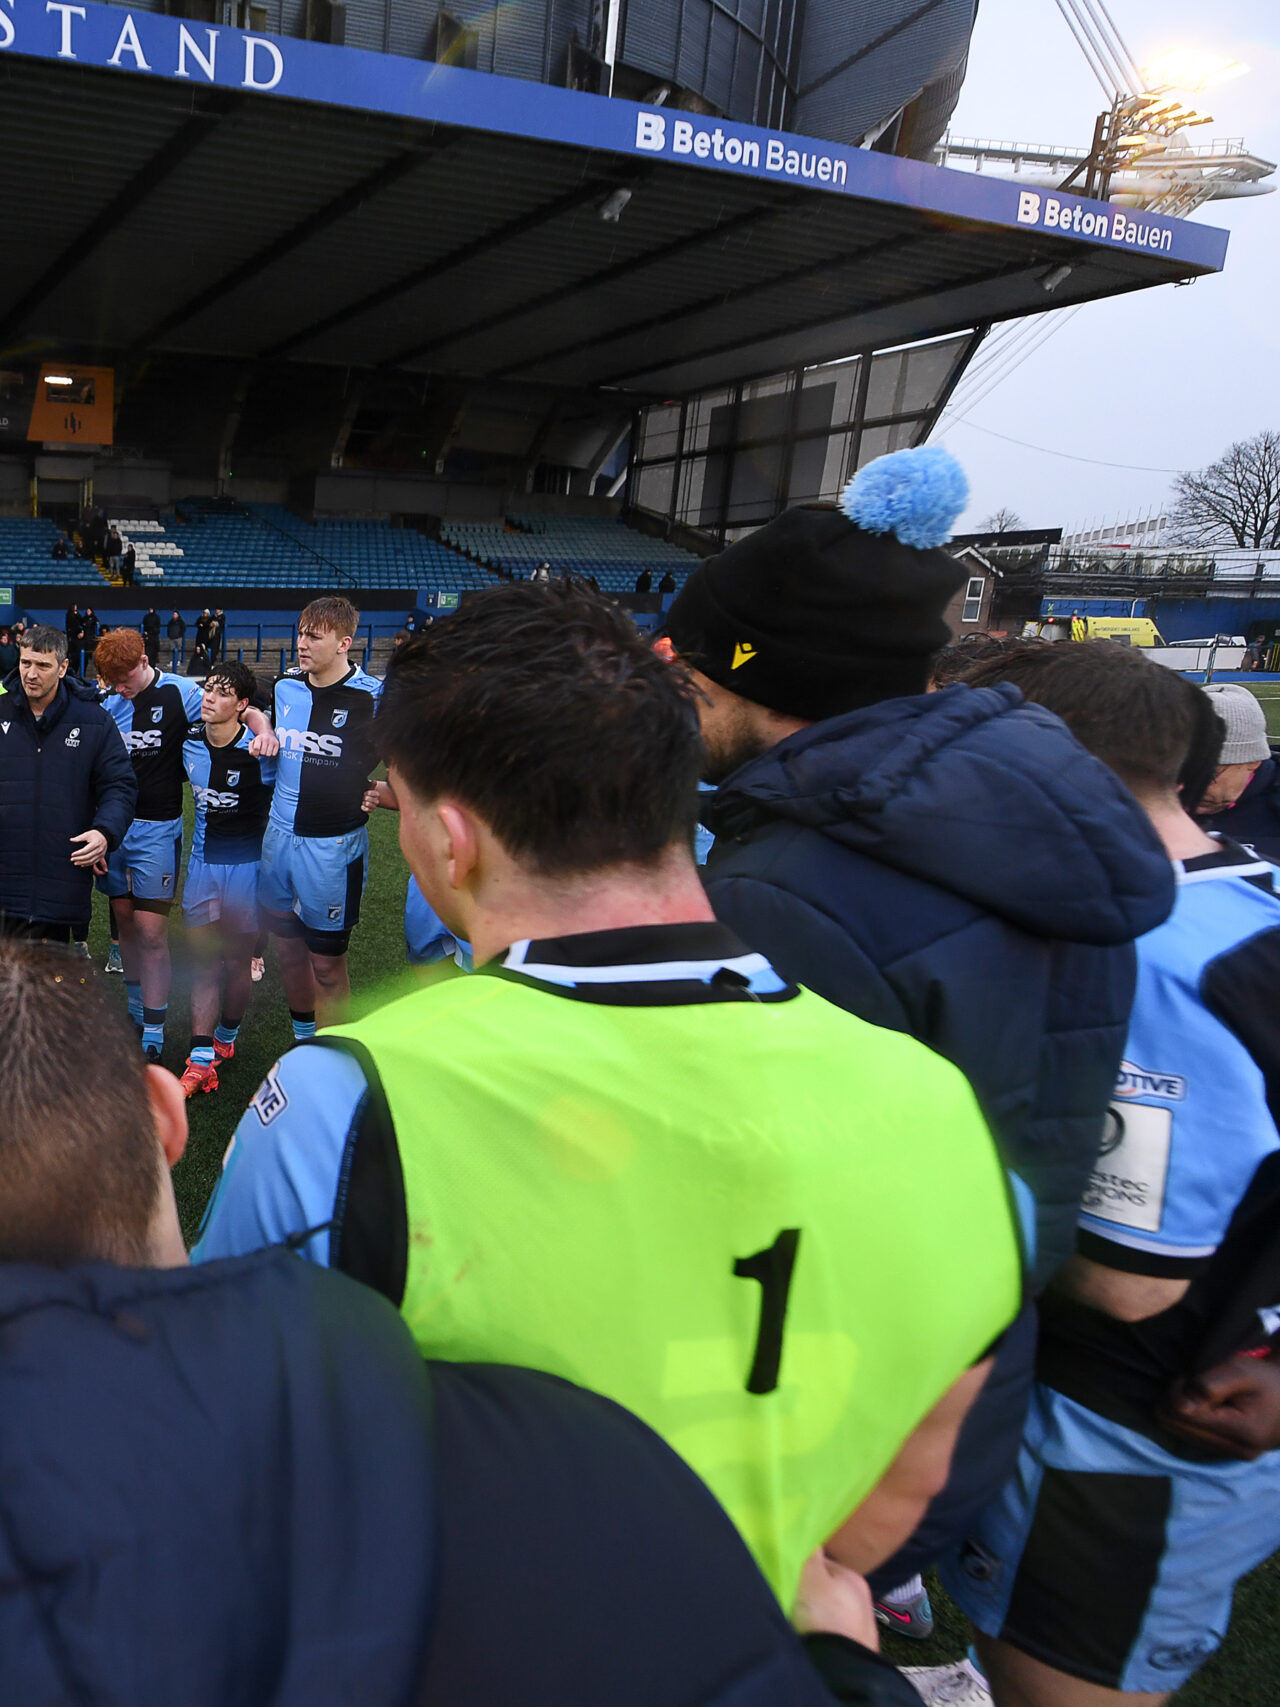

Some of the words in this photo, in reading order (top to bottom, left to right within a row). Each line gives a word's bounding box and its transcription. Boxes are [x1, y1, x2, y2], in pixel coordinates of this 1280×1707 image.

[673, 119, 760, 168] Beton
[765, 138, 848, 187] Bauen
[1043, 199, 1109, 238] Beton
[1111, 211, 1173, 252] Bauen
[120, 729, 163, 750] ss
[282, 750, 298, 761] RSK
[303, 756, 340, 768] ompany
[732, 1227, 802, 1395] 1
